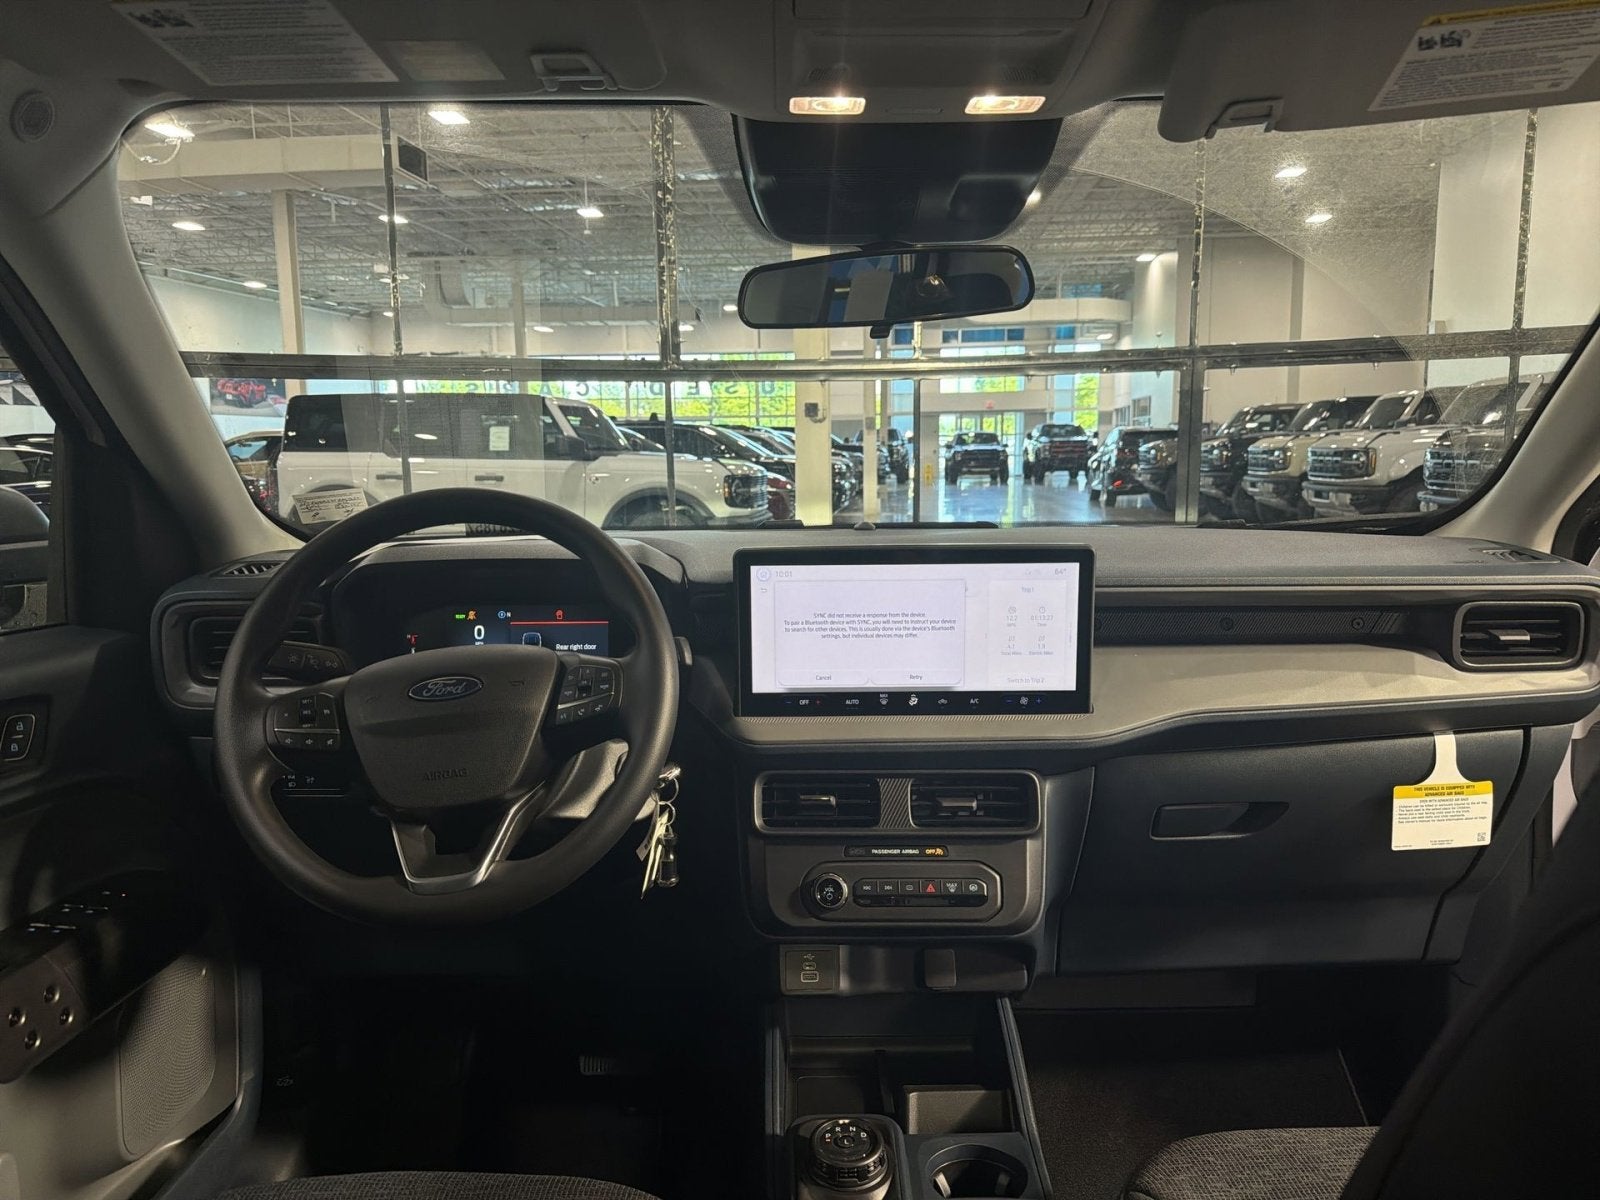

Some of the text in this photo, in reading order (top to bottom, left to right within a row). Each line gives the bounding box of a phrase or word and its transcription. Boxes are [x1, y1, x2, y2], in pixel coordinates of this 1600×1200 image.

[474, 625, 485, 640] 0
[570, 643, 583, 651] right
[422, 679, 466, 697] Ford
[422, 768, 468, 781] AIRBAG
